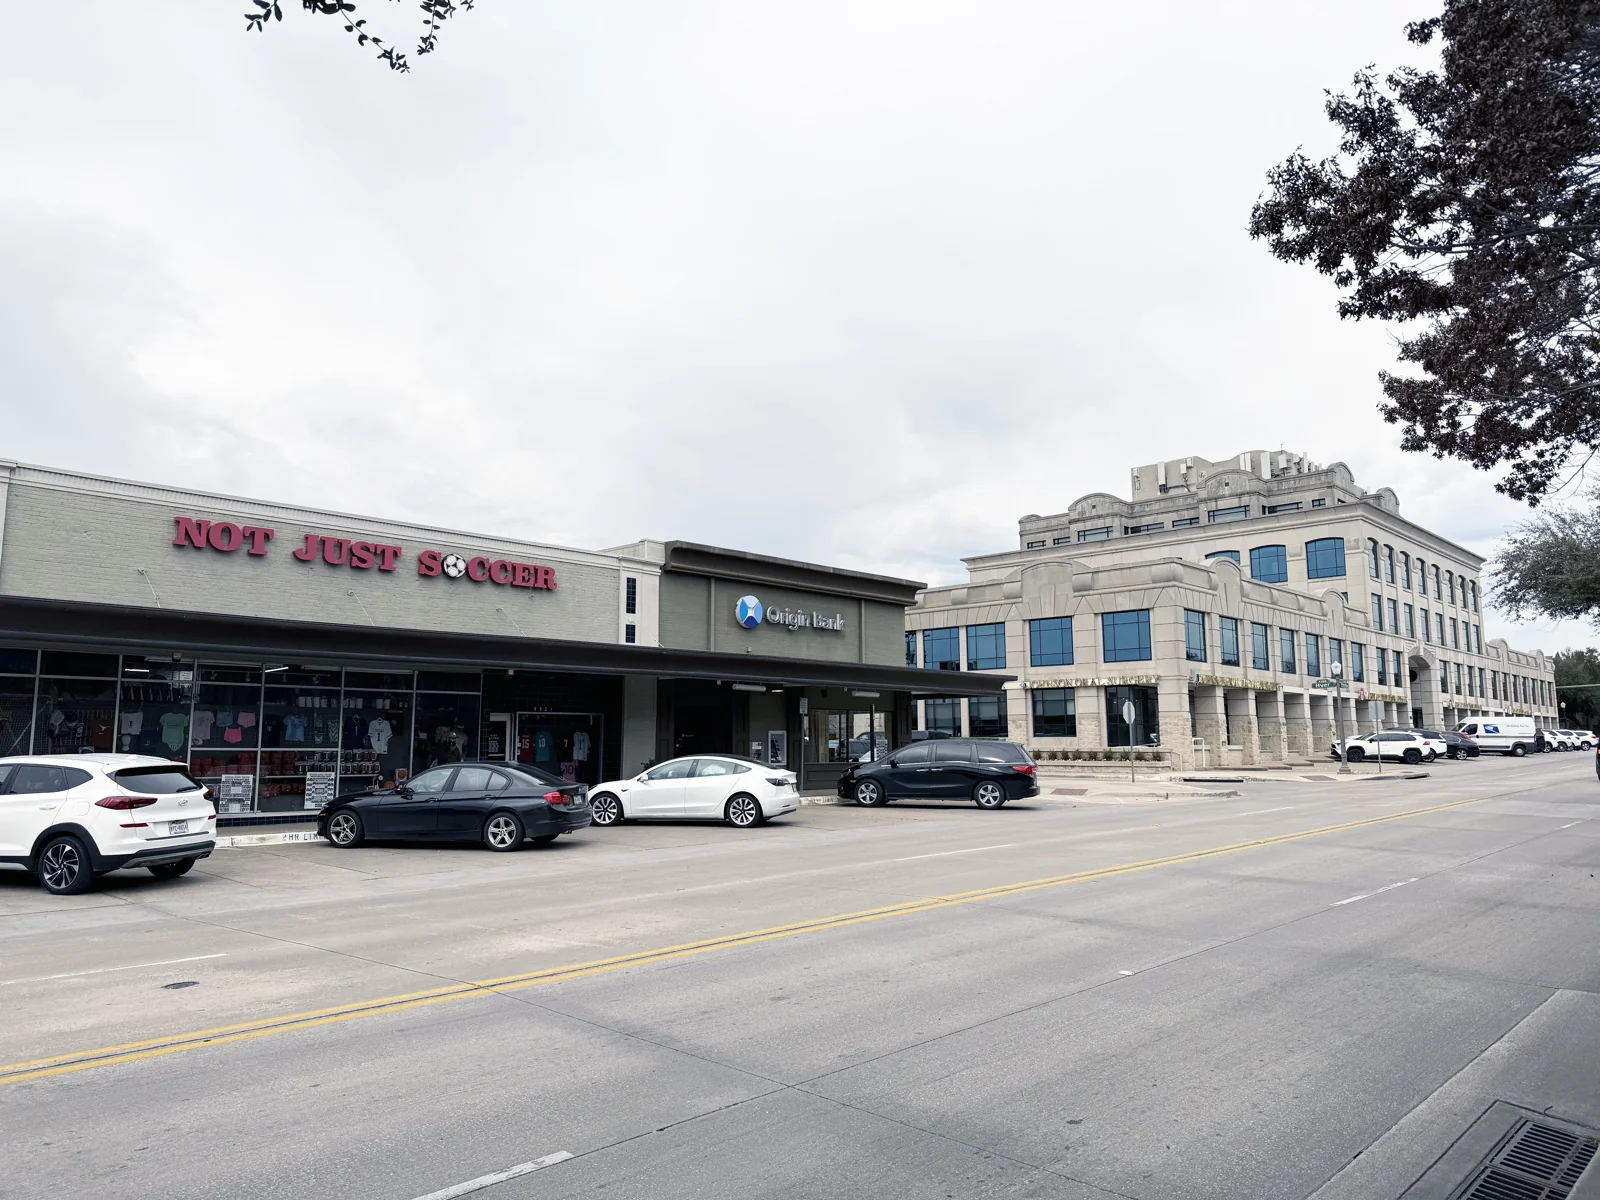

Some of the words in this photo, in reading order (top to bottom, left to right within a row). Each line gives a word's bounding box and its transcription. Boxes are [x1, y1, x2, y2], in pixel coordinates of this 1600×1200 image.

[173, 516, 275, 556] NOT
[293, 534, 402, 571] JUST
[766, 605, 809, 630] Origin
[812, 611, 846, 630] Bank
[521, 739, 530, 749] 15
[538, 738, 546, 748] 10
[563, 739, 569, 748] 7
